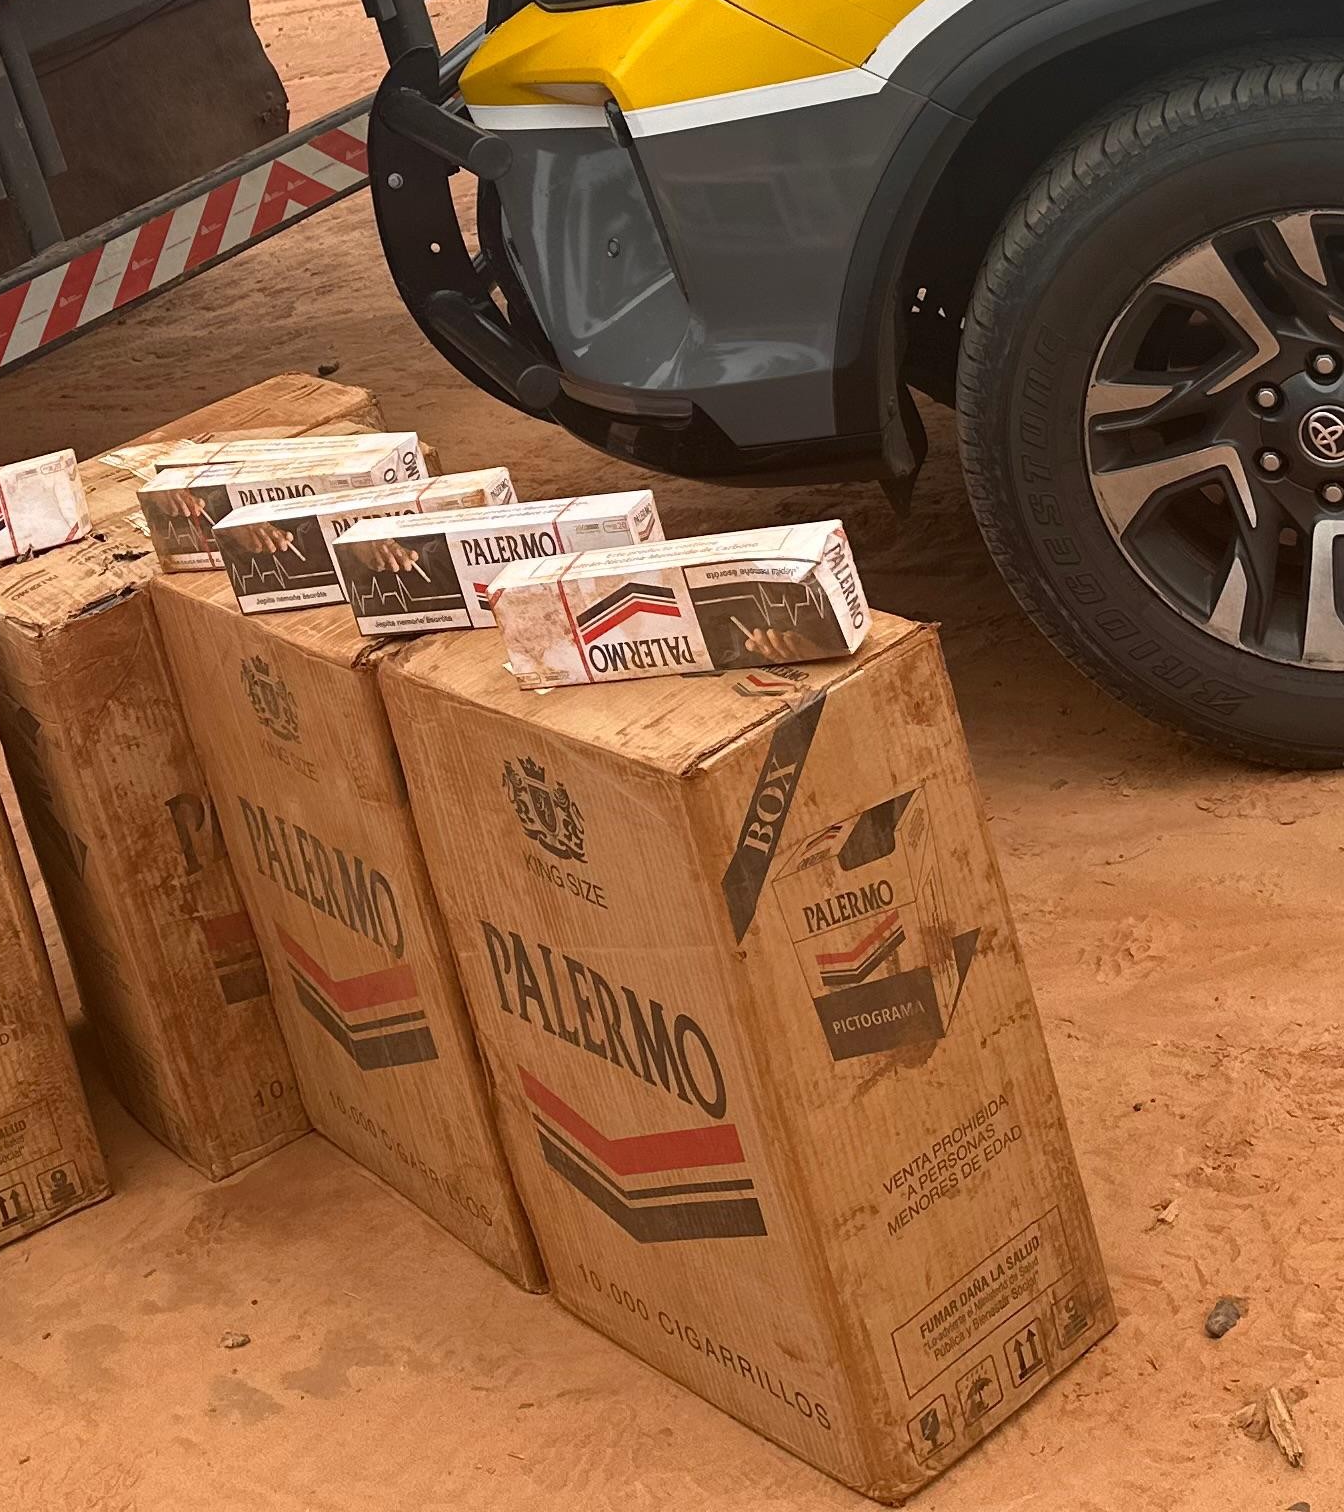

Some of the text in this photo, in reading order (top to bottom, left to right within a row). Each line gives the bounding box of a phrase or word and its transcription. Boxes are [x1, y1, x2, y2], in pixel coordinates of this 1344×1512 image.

[461, 531, 557, 566] PALERMO
[1019, 323, 1258, 718] BRIDGESTONE
[823, 543, 864, 630] PALERMO
[589, 636, 697, 673] PALERMO
[742, 760, 797, 857] BOX
[237, 795, 405, 960] PALERMO
[523, 852, 609, 910] KING SIZE
[802, 879, 894, 934] PALERMO
[481, 919, 728, 1120] PALERMO
[832, 1000, 925, 1035] PICTOGRAMA
[883, 1094, 1009, 1194] VENTA PROHIBIDA
[887, 1124, 1023, 1237] MENORES DE EDAD
[907, 1123, 996, 1201] A PERSONAS
[919, 1236, 1040, 1339] FUMAR DAÑA LA SALUD
[577, 1263, 833, 1431] 10.000 CIGARRILLOS
